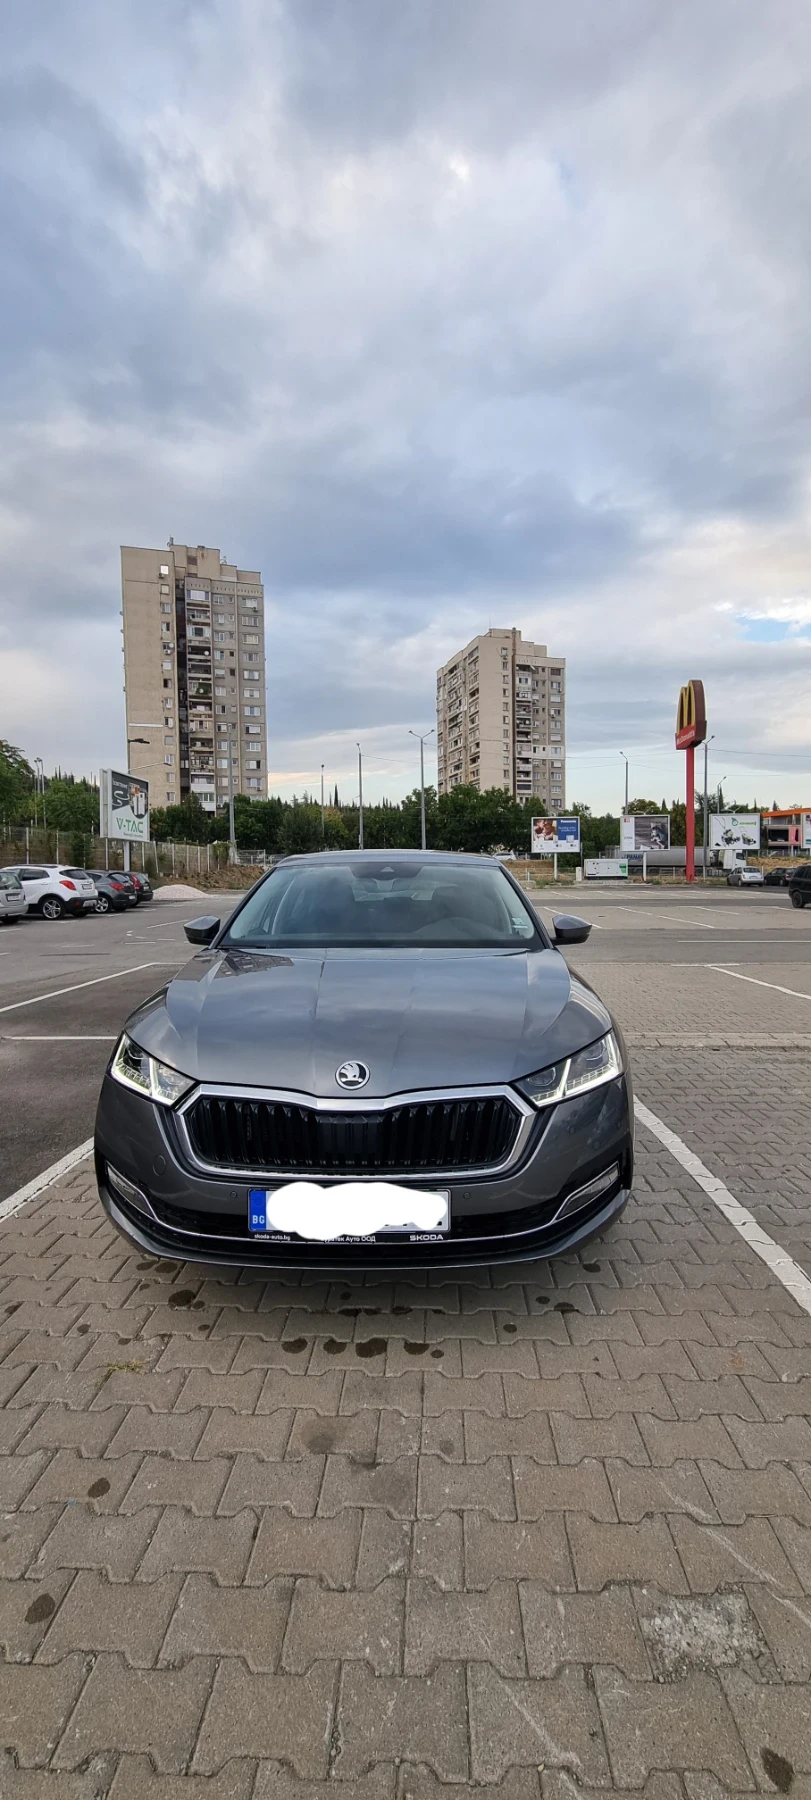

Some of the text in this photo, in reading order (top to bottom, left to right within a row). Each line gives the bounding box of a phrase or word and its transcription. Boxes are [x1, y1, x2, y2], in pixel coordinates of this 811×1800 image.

[116, 817, 144, 834] V-TAC
[252, 1215, 265, 1224] BG
[254, 1233, 291, 1241] skoda-auto.bg
[361, 1235, 376, 1243] ООД
